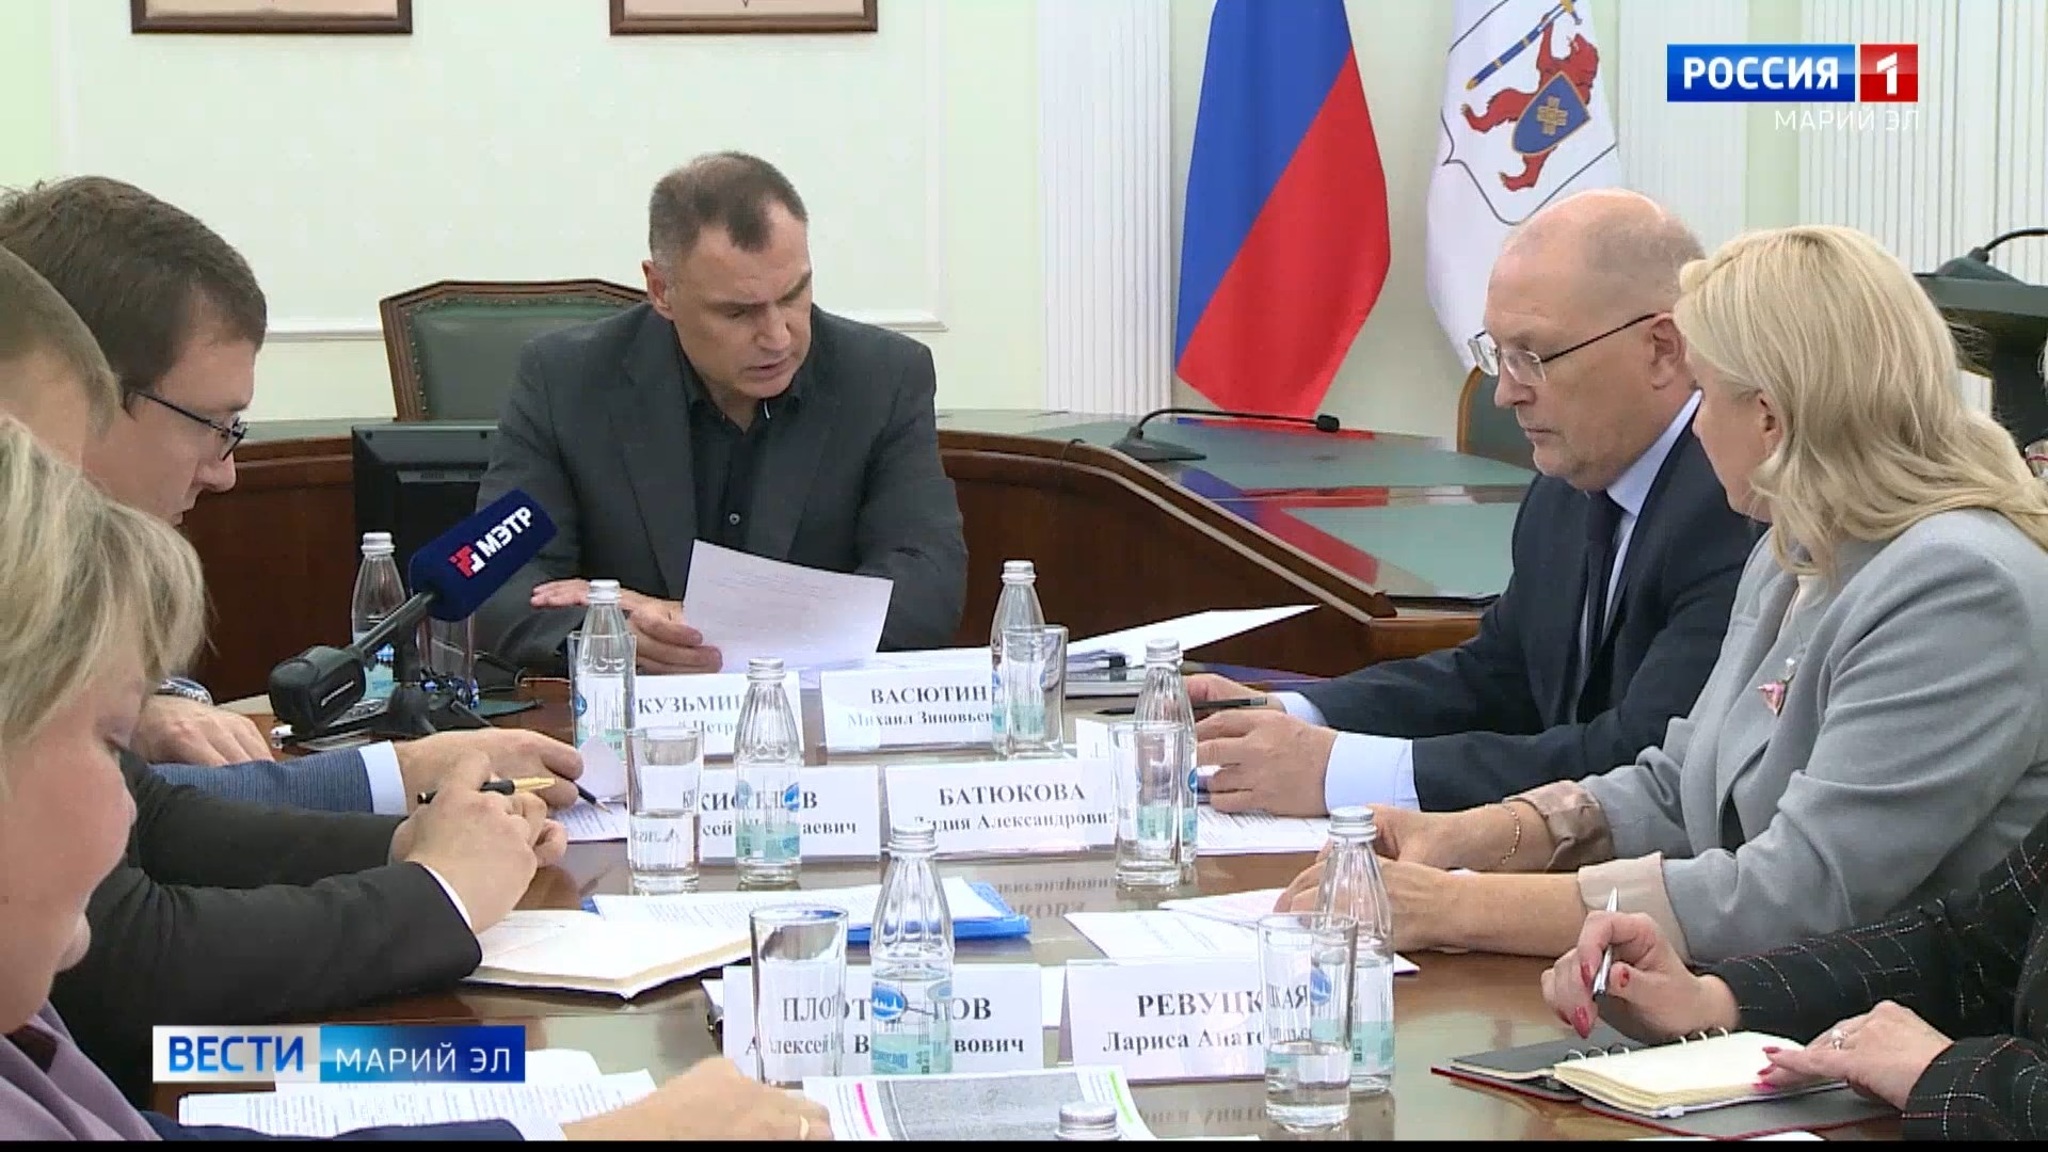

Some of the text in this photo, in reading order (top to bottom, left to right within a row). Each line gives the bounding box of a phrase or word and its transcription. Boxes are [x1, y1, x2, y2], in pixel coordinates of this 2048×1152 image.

[475, 506, 532, 558] МЭТР
[638, 694, 741, 714] КУЗЬМИ
[871, 685, 988, 704] ВАСЮТИН
[847, 711, 913, 727] Михаил
[939, 782, 1086, 806] БАТЮКОВА
[976, 811, 1116, 831] Александровн
[782, 997, 992, 1022] ПЛОТОВ
[1102, 1030, 1189, 1056] Лариса
